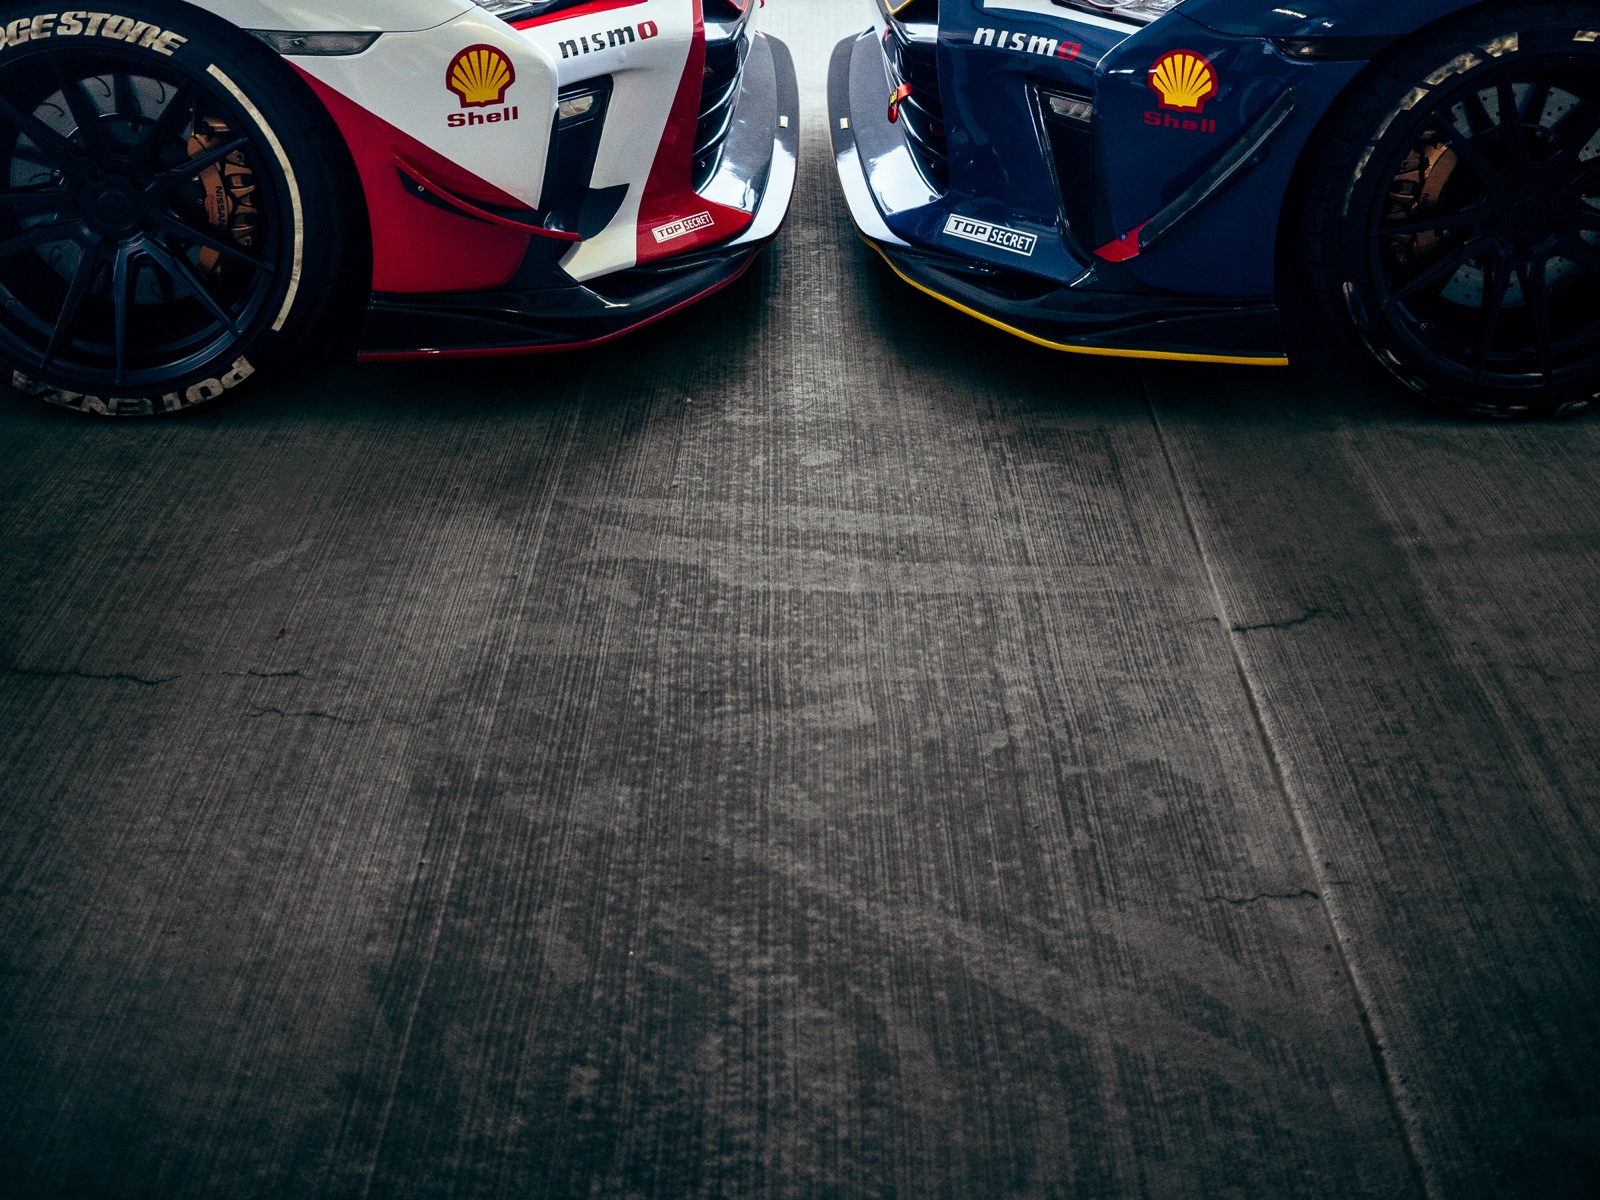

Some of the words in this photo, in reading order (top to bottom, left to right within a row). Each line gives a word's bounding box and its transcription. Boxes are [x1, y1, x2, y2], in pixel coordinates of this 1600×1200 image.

[558, 20, 658, 59] nismo
[972, 27, 1082, 61] nismo
[447, 106, 518, 128] Shell
[1143, 110, 1216, 133] Shell
[215, 185, 227, 227] NISSAN
[657, 223, 682, 237] TOP
[683, 214, 711, 231] SECRET
[953, 219, 988, 236] TOP
[989, 229, 1033, 251] SECRET
